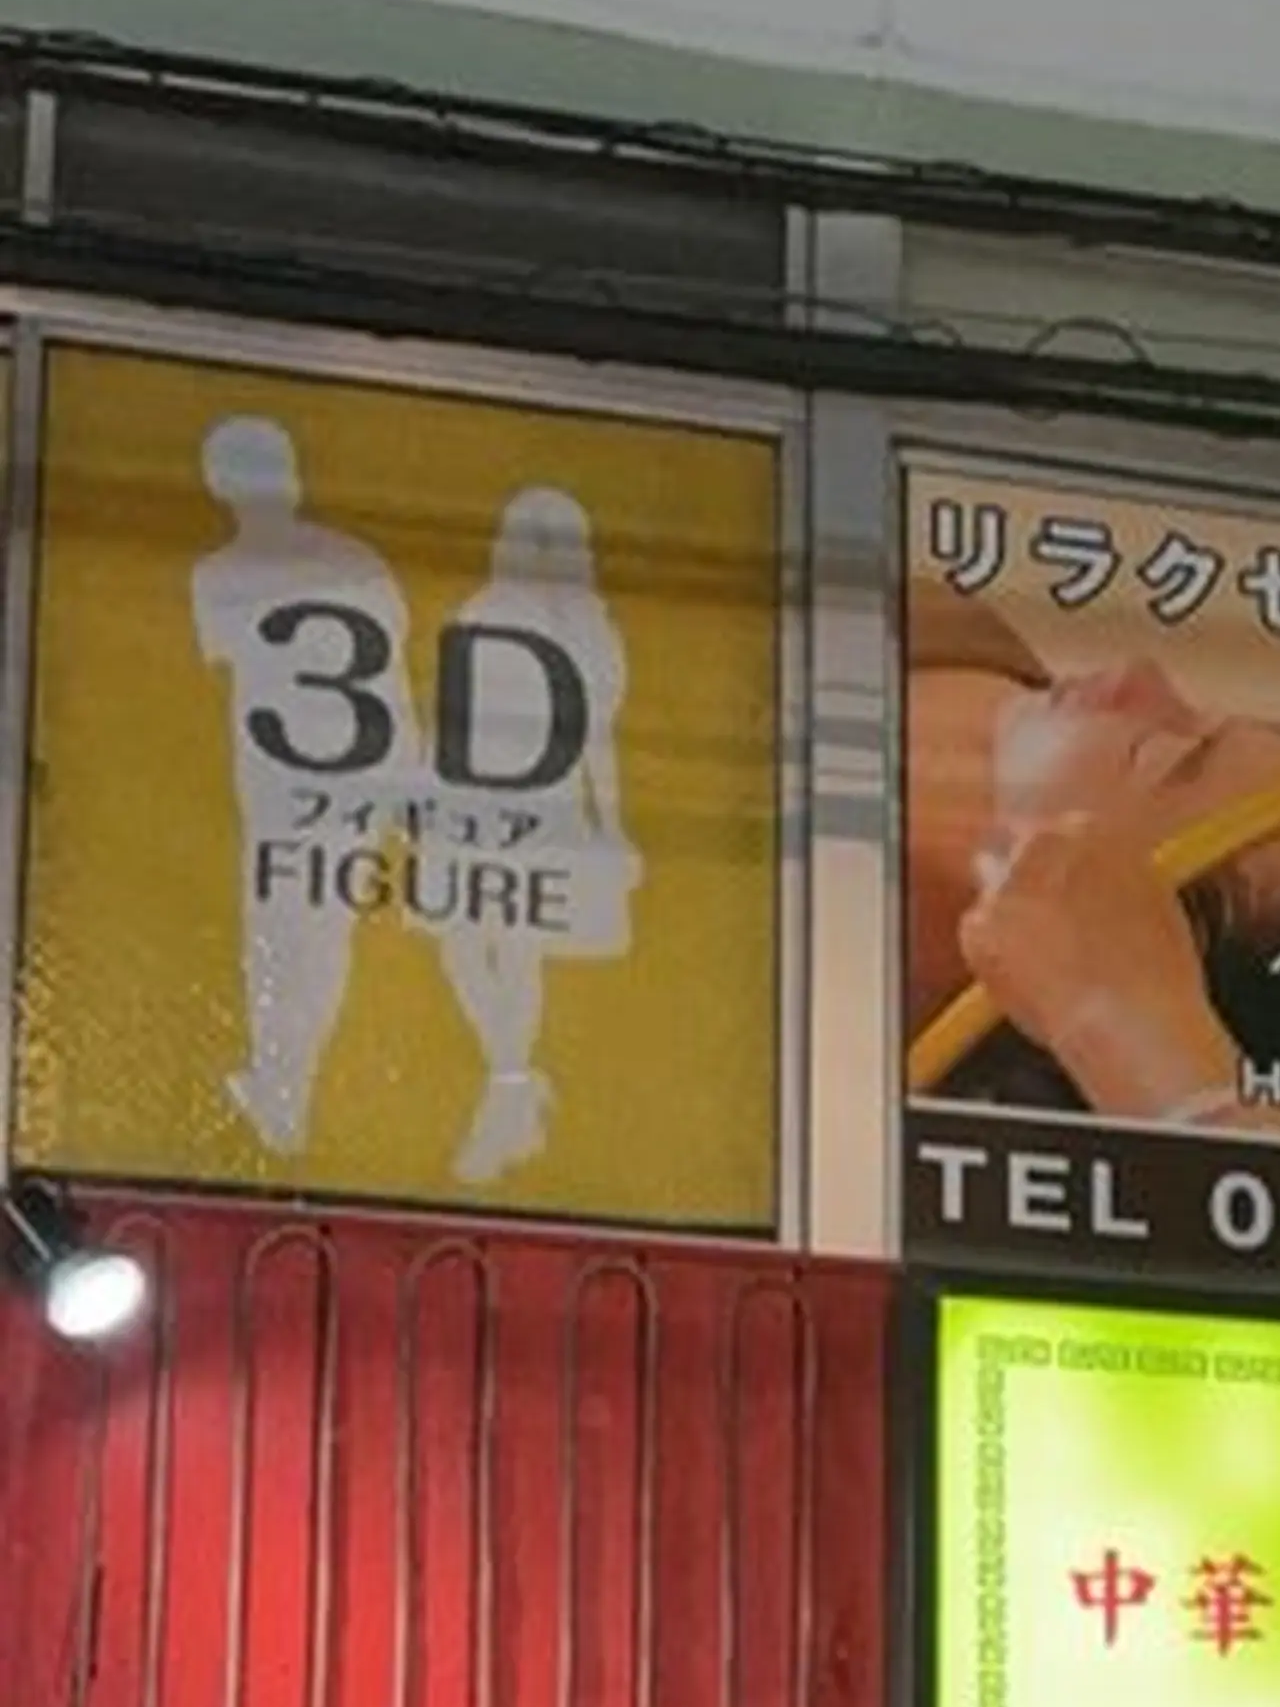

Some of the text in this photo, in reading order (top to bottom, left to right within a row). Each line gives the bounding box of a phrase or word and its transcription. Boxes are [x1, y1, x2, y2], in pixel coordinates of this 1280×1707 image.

[247, 602, 589, 791] 3D
[256, 841, 573, 933] FIGURE
[916, 1144, 1151, 1239] TEL
[1069, 1547, 1279, 1658] 中華
